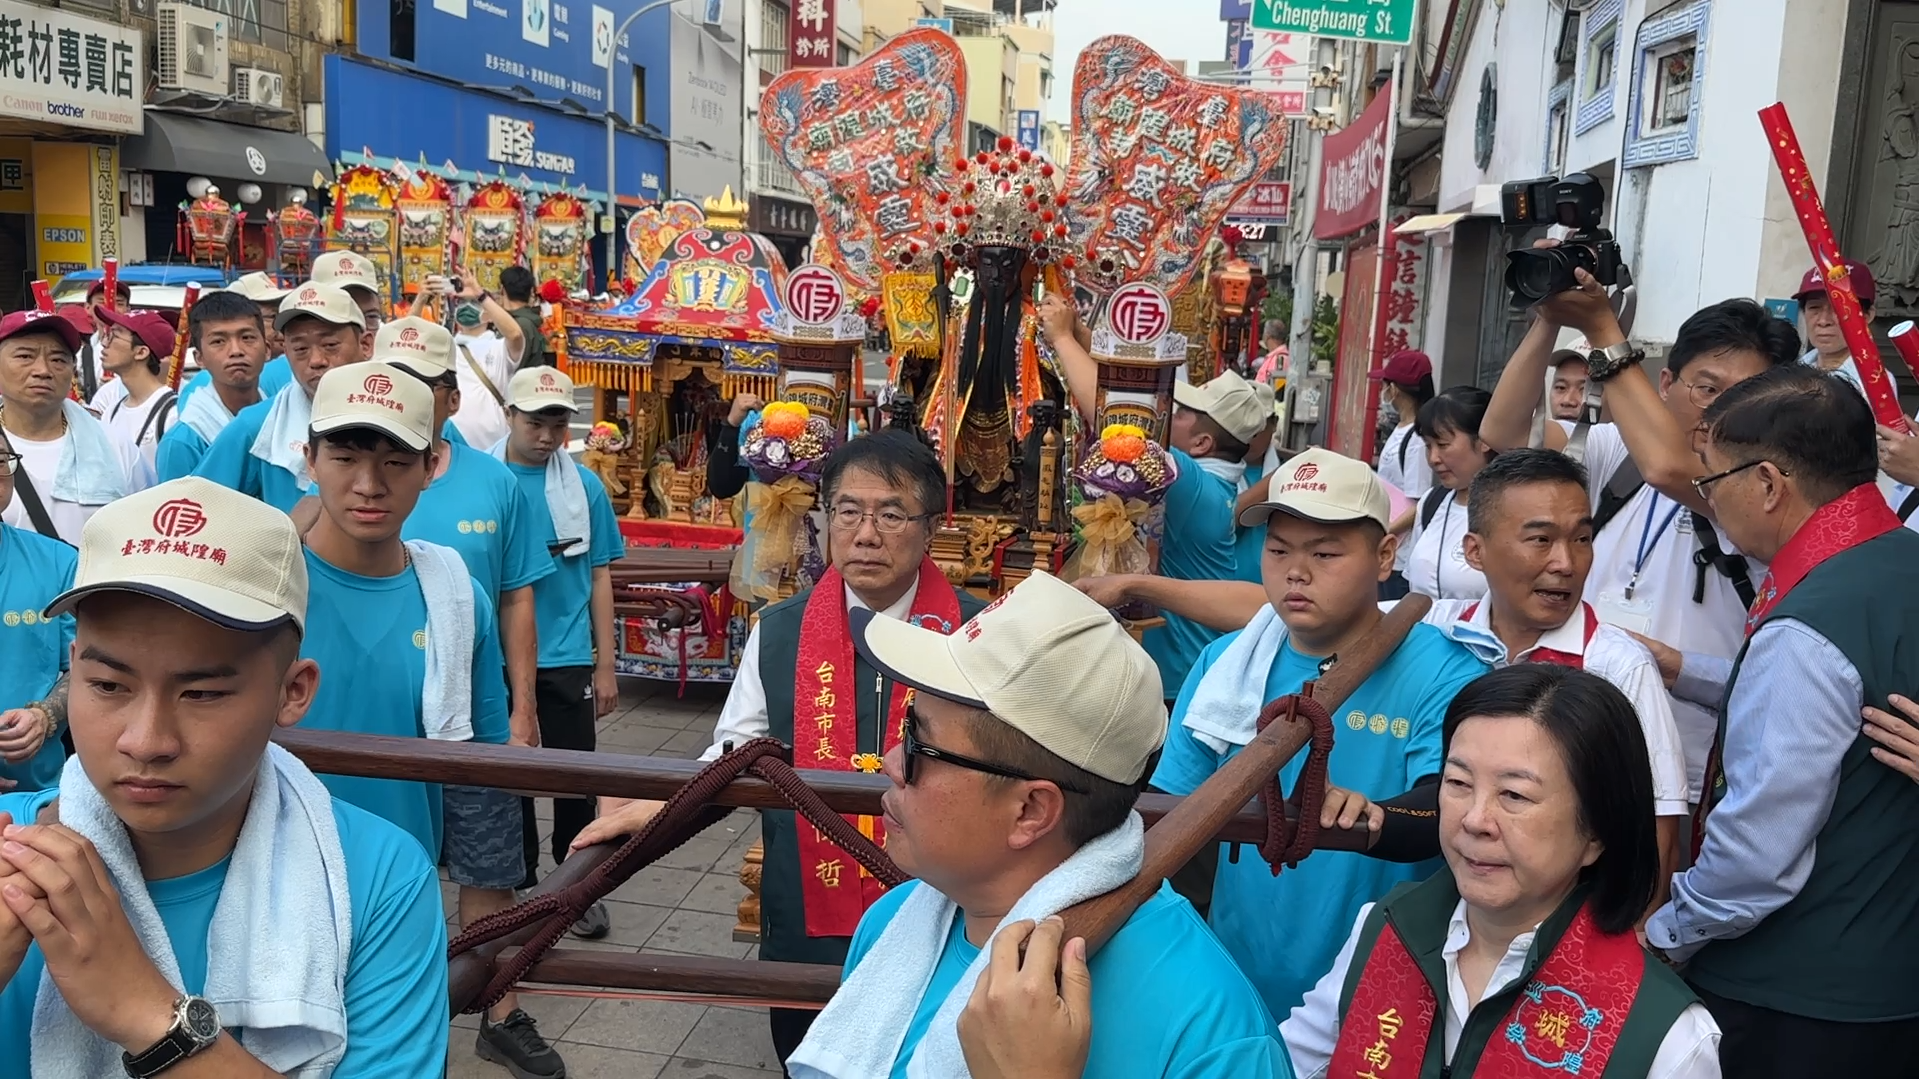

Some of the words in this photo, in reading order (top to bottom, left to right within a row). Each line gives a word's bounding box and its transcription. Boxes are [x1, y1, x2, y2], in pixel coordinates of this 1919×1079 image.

[796, 0, 829, 33] 科
[1271, 1, 1368, 37] Chenghuang
[1374, 10, 1394, 35] St.
[0, 13, 133, 99] 耗材專賣店
[795, 37, 831, 59] 診所
[3, 95, 43, 113] Canon
[47, 100, 85, 119] brother
[488, 113, 535, 168] 順發
[97, 146, 117, 257] 雷射印表
[43, 228, 86, 243] EPSON
[346, 394, 404, 414] 臺灣府城隍廟
[121, 538, 228, 567] 臺灣府城隍廟
[813, 660, 837, 762] 台南市長
[1533, 1008, 1571, 1048] 城
